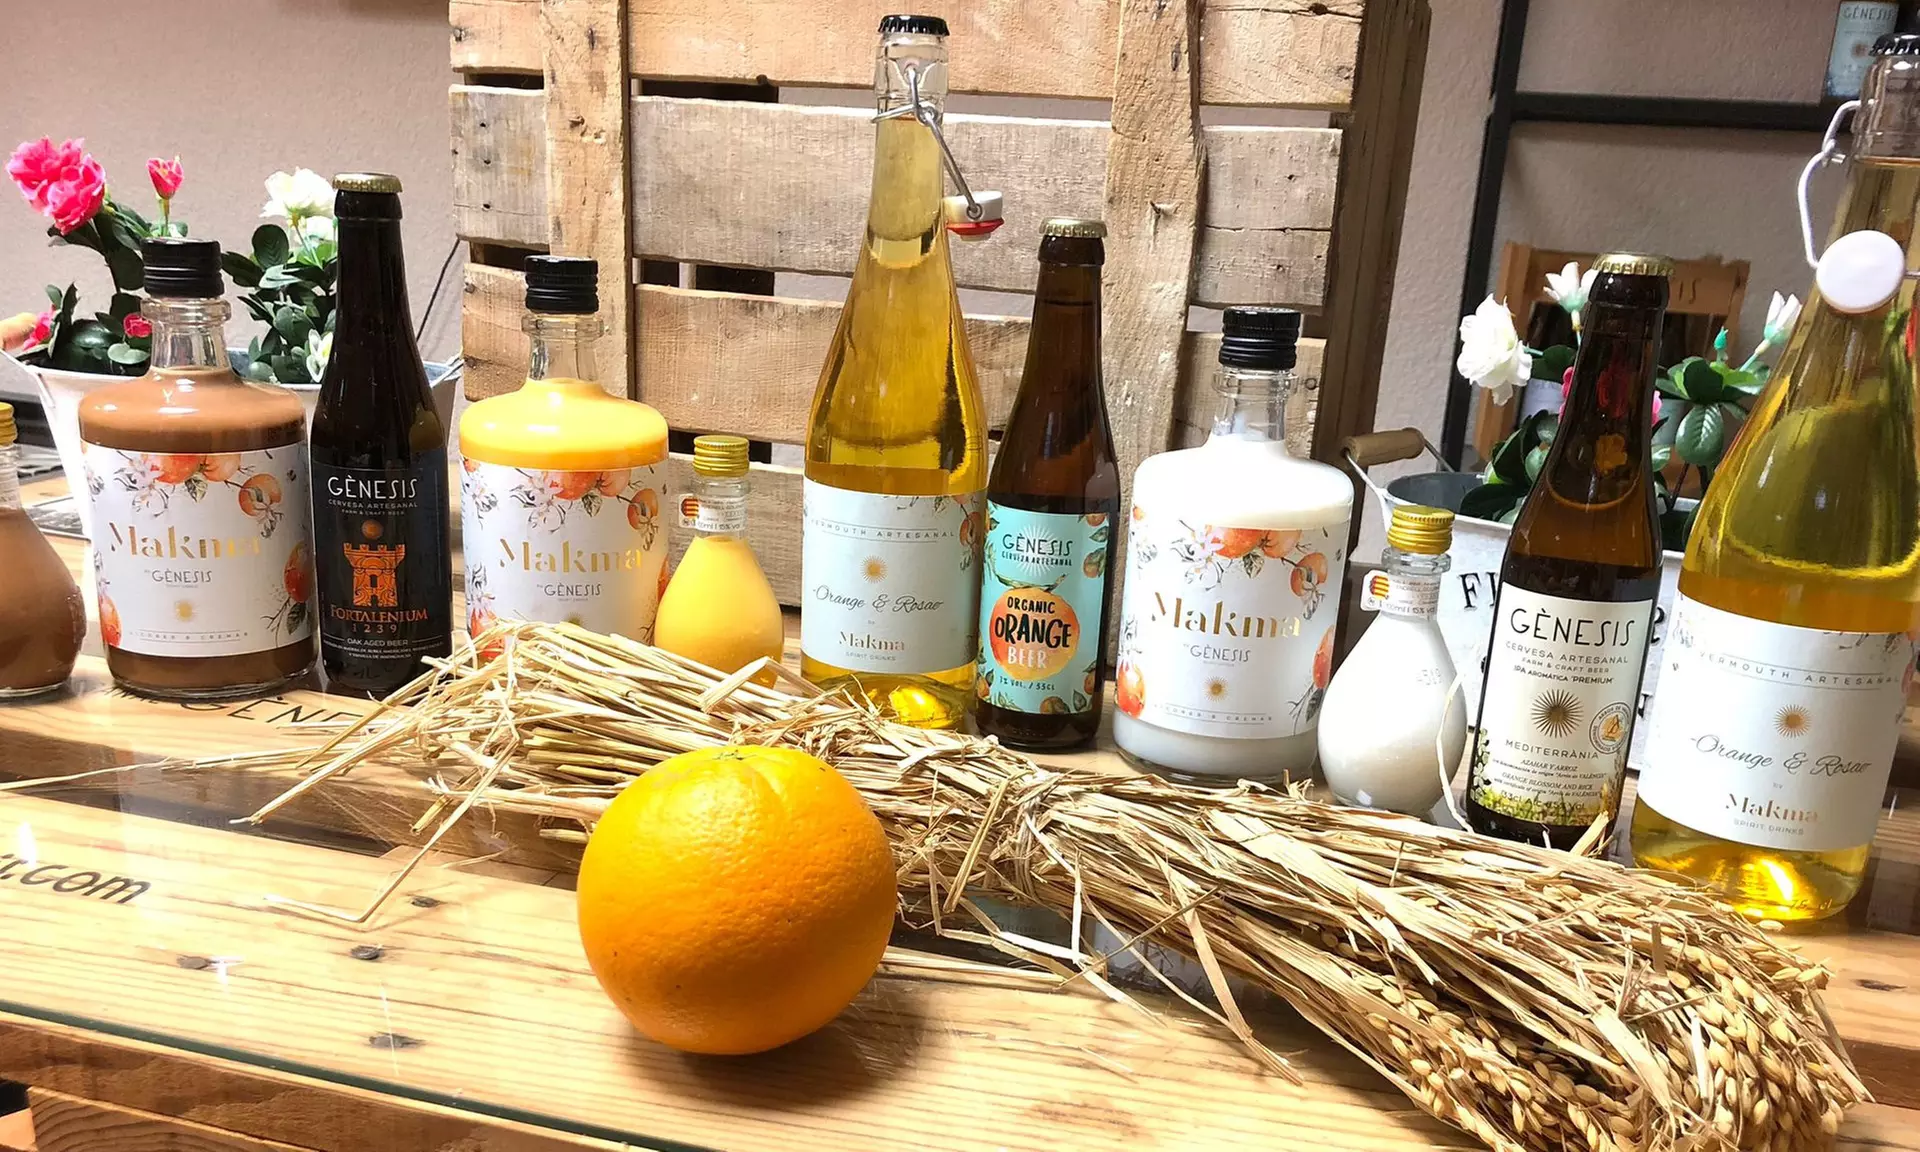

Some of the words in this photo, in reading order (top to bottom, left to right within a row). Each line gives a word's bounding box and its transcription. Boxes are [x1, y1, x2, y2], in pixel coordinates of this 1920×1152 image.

[328, 475, 418, 499] GÈNESIS
[328, 499, 364, 508] CERVESA
[108, 521, 261, 559] Makma
[1002, 533, 1073, 556] GÈNESIS
[499, 537, 642, 573] Makma
[1031, 556, 1072, 566] ARTESANAL
[152, 568, 212, 583] GÈNESIS
[544, 582, 601, 596] GÈNESIS
[330, 604, 428, 623] FORTALENIUM
[872, 594, 890, 613] &
[1007, 596, 1055, 614] ORGANIC
[1151, 591, 1301, 638] Makma
[994, 613, 1072, 649] ORANGE
[1510, 608, 1636, 647] GÈNESIS
[364, 639, 385, 647] AGED
[387, 639, 408, 647] BEER
[839, 631, 905, 651] Makma
[1007, 646, 1047, 669] BEER
[1190, 644, 1251, 662] GÈNESIS
[1505, 641, 1554, 659] CERVESA
[1560, 654, 1628, 664] ARTESANAL
[1521, 657, 1543, 666] FARM
[1555, 664, 1584, 673] CRAFT
[1700, 651, 1790, 679] VERMOUTH
[1505, 739, 1599, 759] MEDITERRÀNIA
[1783, 752, 1809, 775] &
[1725, 792, 1819, 822] Makma
[1733, 818, 1765, 830] SPIRIT
[1768, 824, 1805, 836] DRINKS
